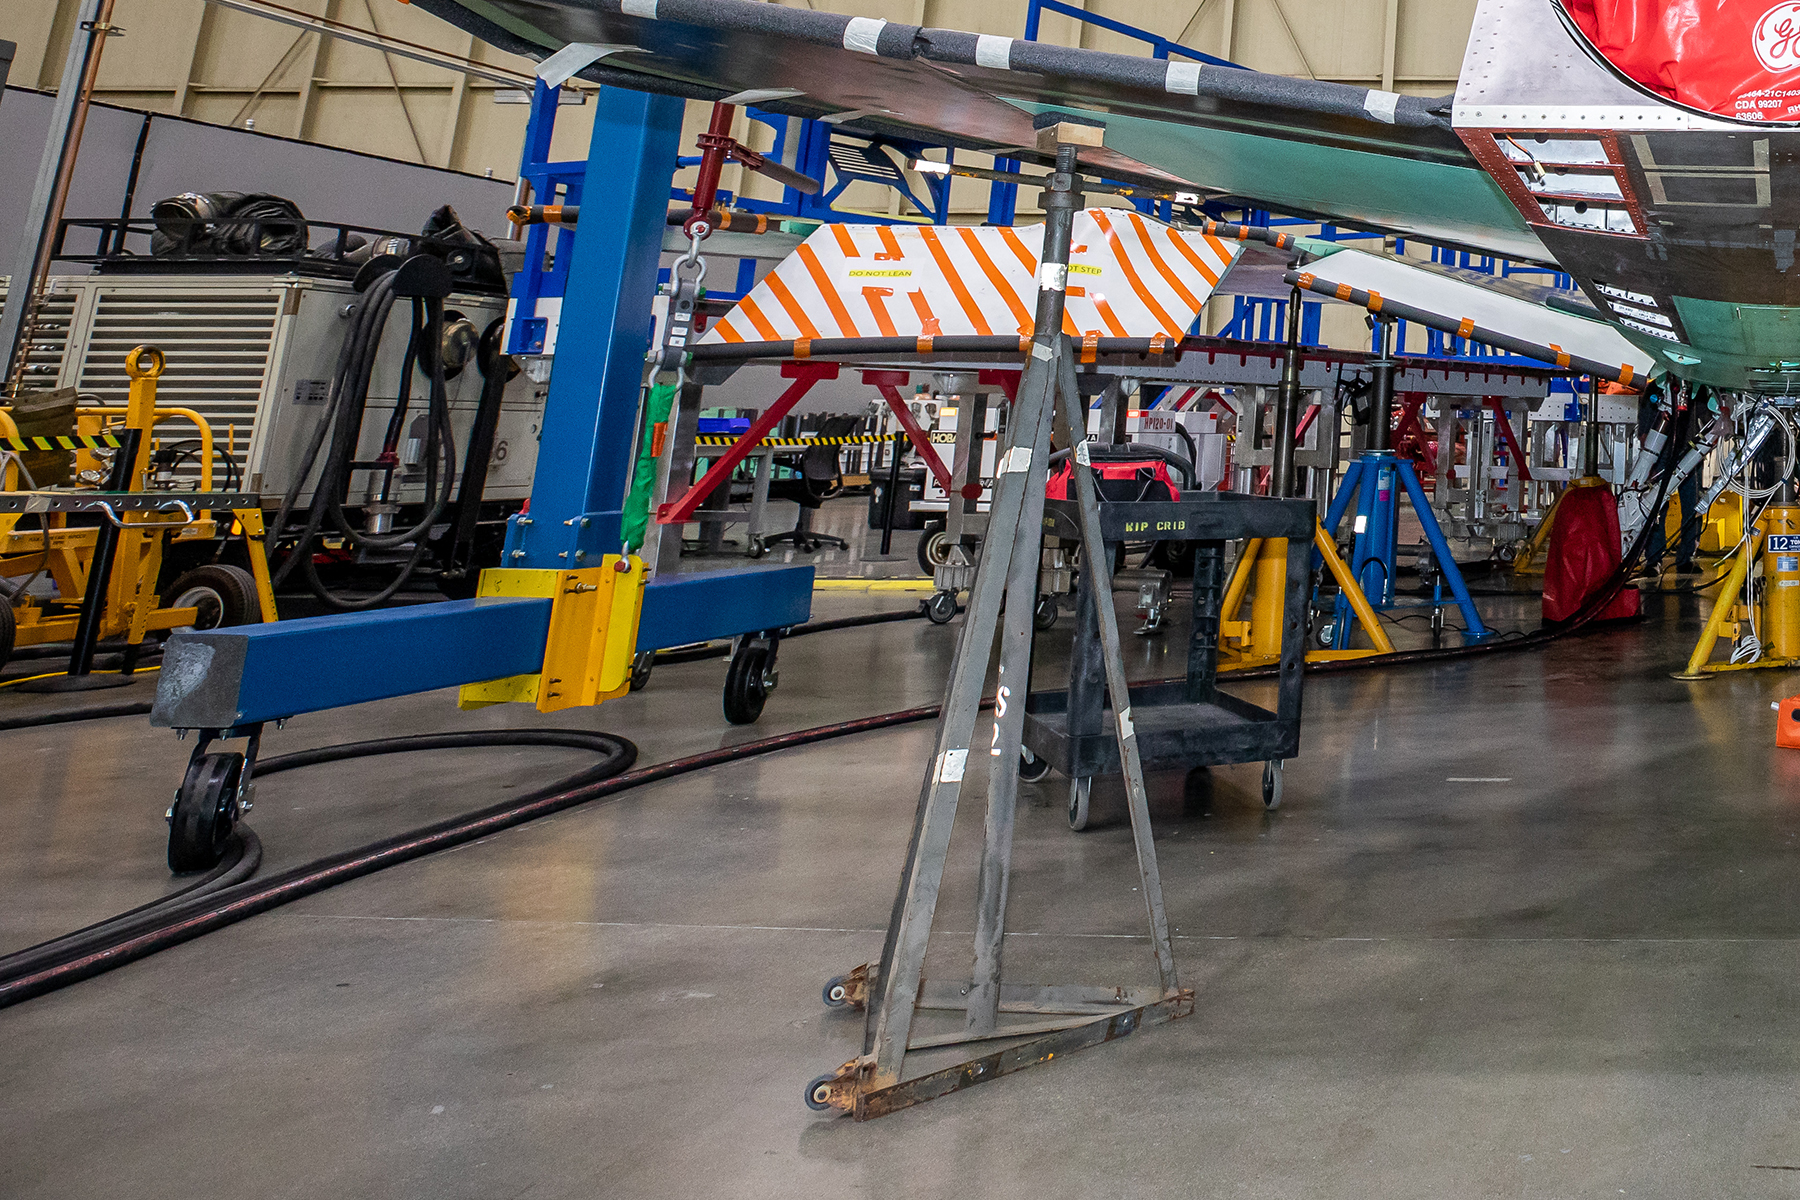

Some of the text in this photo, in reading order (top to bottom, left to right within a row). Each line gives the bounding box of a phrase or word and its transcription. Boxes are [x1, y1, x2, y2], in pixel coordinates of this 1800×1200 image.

[1735, 99, 1783, 110] CDA 99207
[1068, 264, 1102, 275] OT STEP
[932, 433, 956, 443] HOBA
[1156, 520, 1186, 531] CRIB
[1773, 536, 1788, 550] 12
